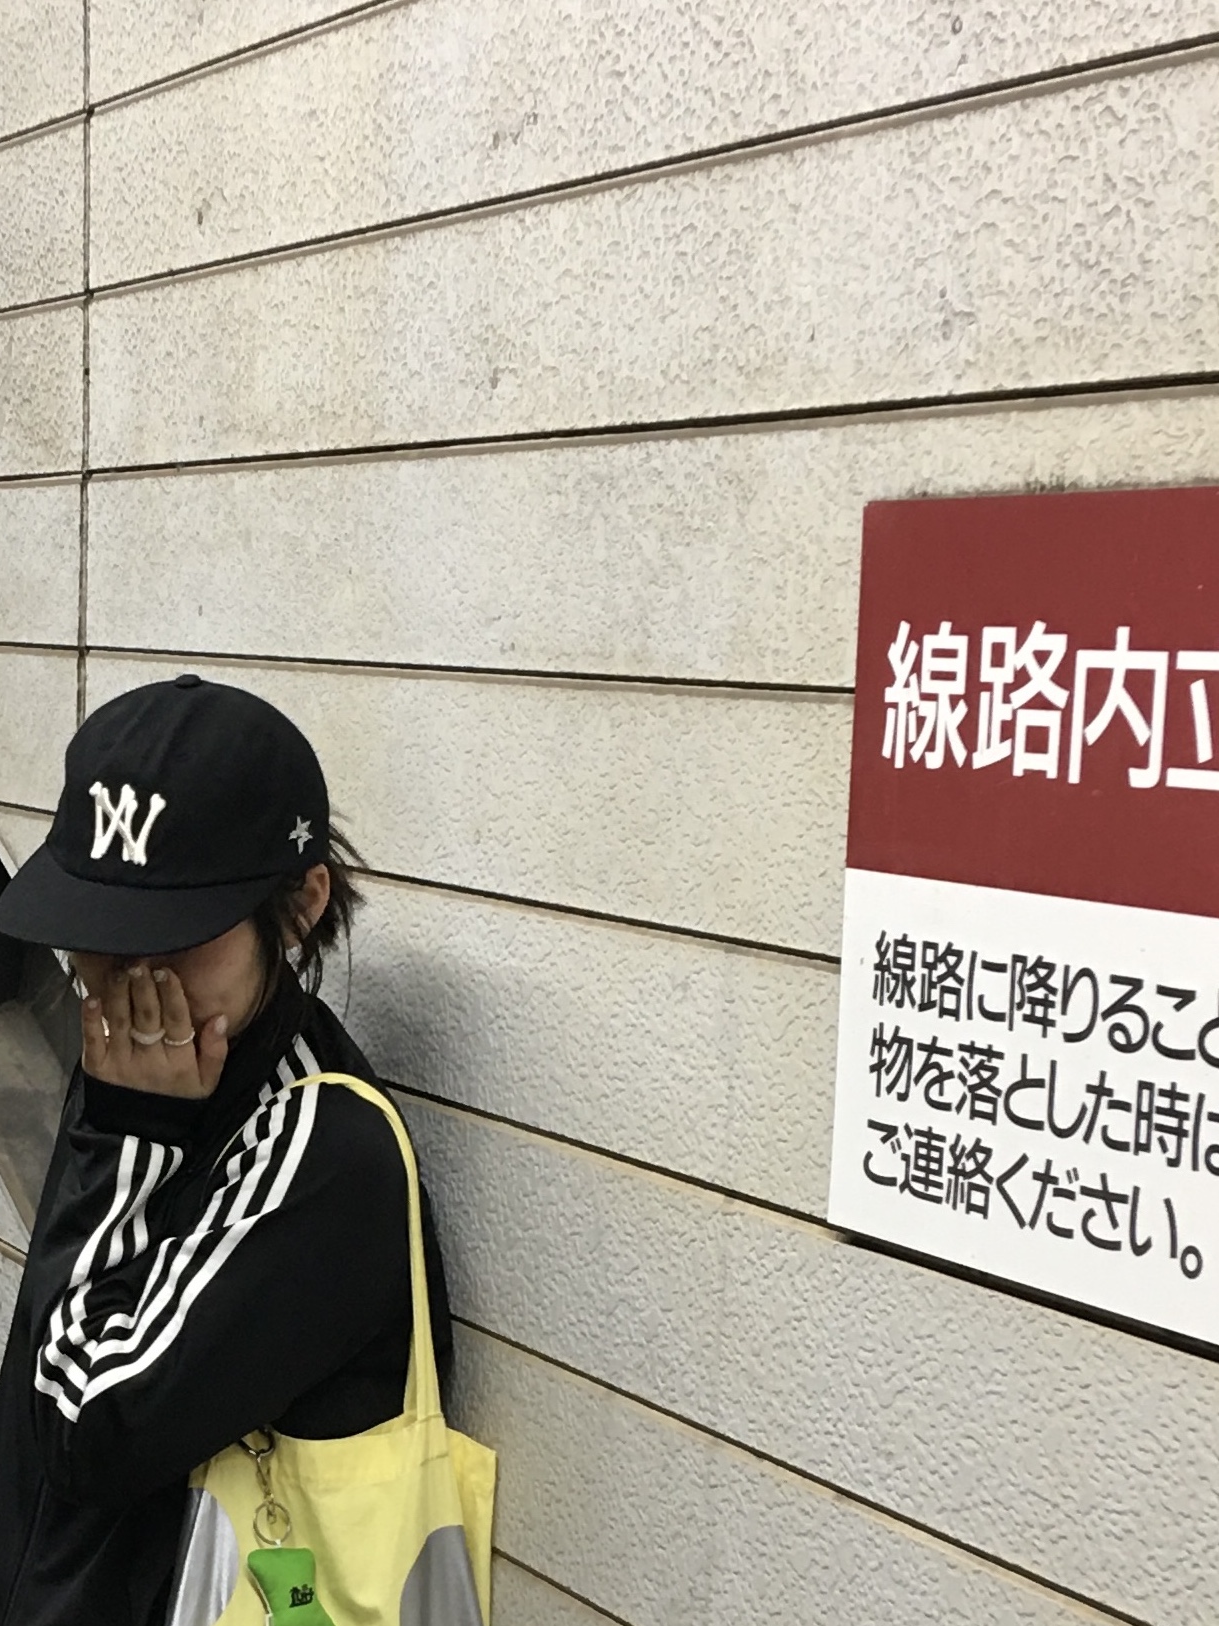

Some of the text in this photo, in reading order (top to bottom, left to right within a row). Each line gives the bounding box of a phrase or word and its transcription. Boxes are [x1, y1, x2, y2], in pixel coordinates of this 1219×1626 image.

[868, 1021, 1219, 1178] 物を落とした時は
[863, 1118, 1204, 1280] ご連絡ください。
